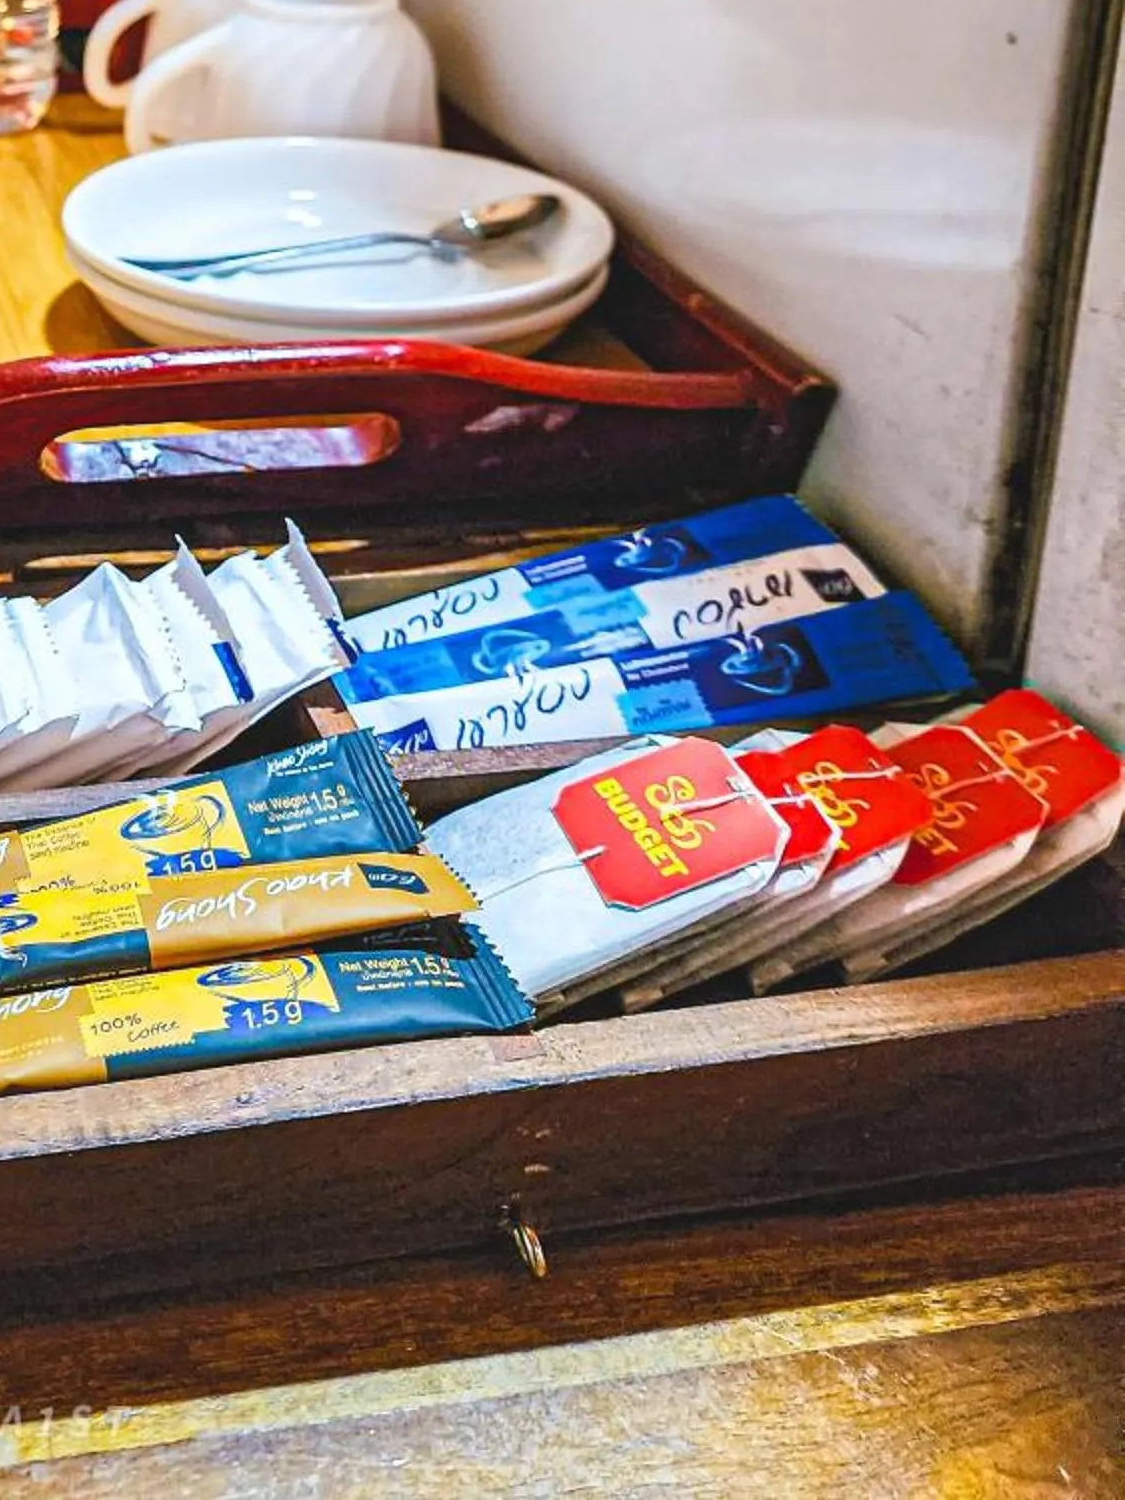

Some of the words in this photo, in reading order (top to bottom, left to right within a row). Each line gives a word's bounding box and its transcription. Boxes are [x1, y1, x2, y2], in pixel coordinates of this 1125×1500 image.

[269, 793, 310, 813] Weight
[593, 777, 689, 877] BUDGET
[266, 863, 353, 896] Khao
[155, 878, 267, 931] Shong
[339, 960, 363, 973] Net
[364, 956, 409, 972] Weight
[90, 1013, 142, 1035] 100%
[127, 1019, 180, 1043] Coffee
